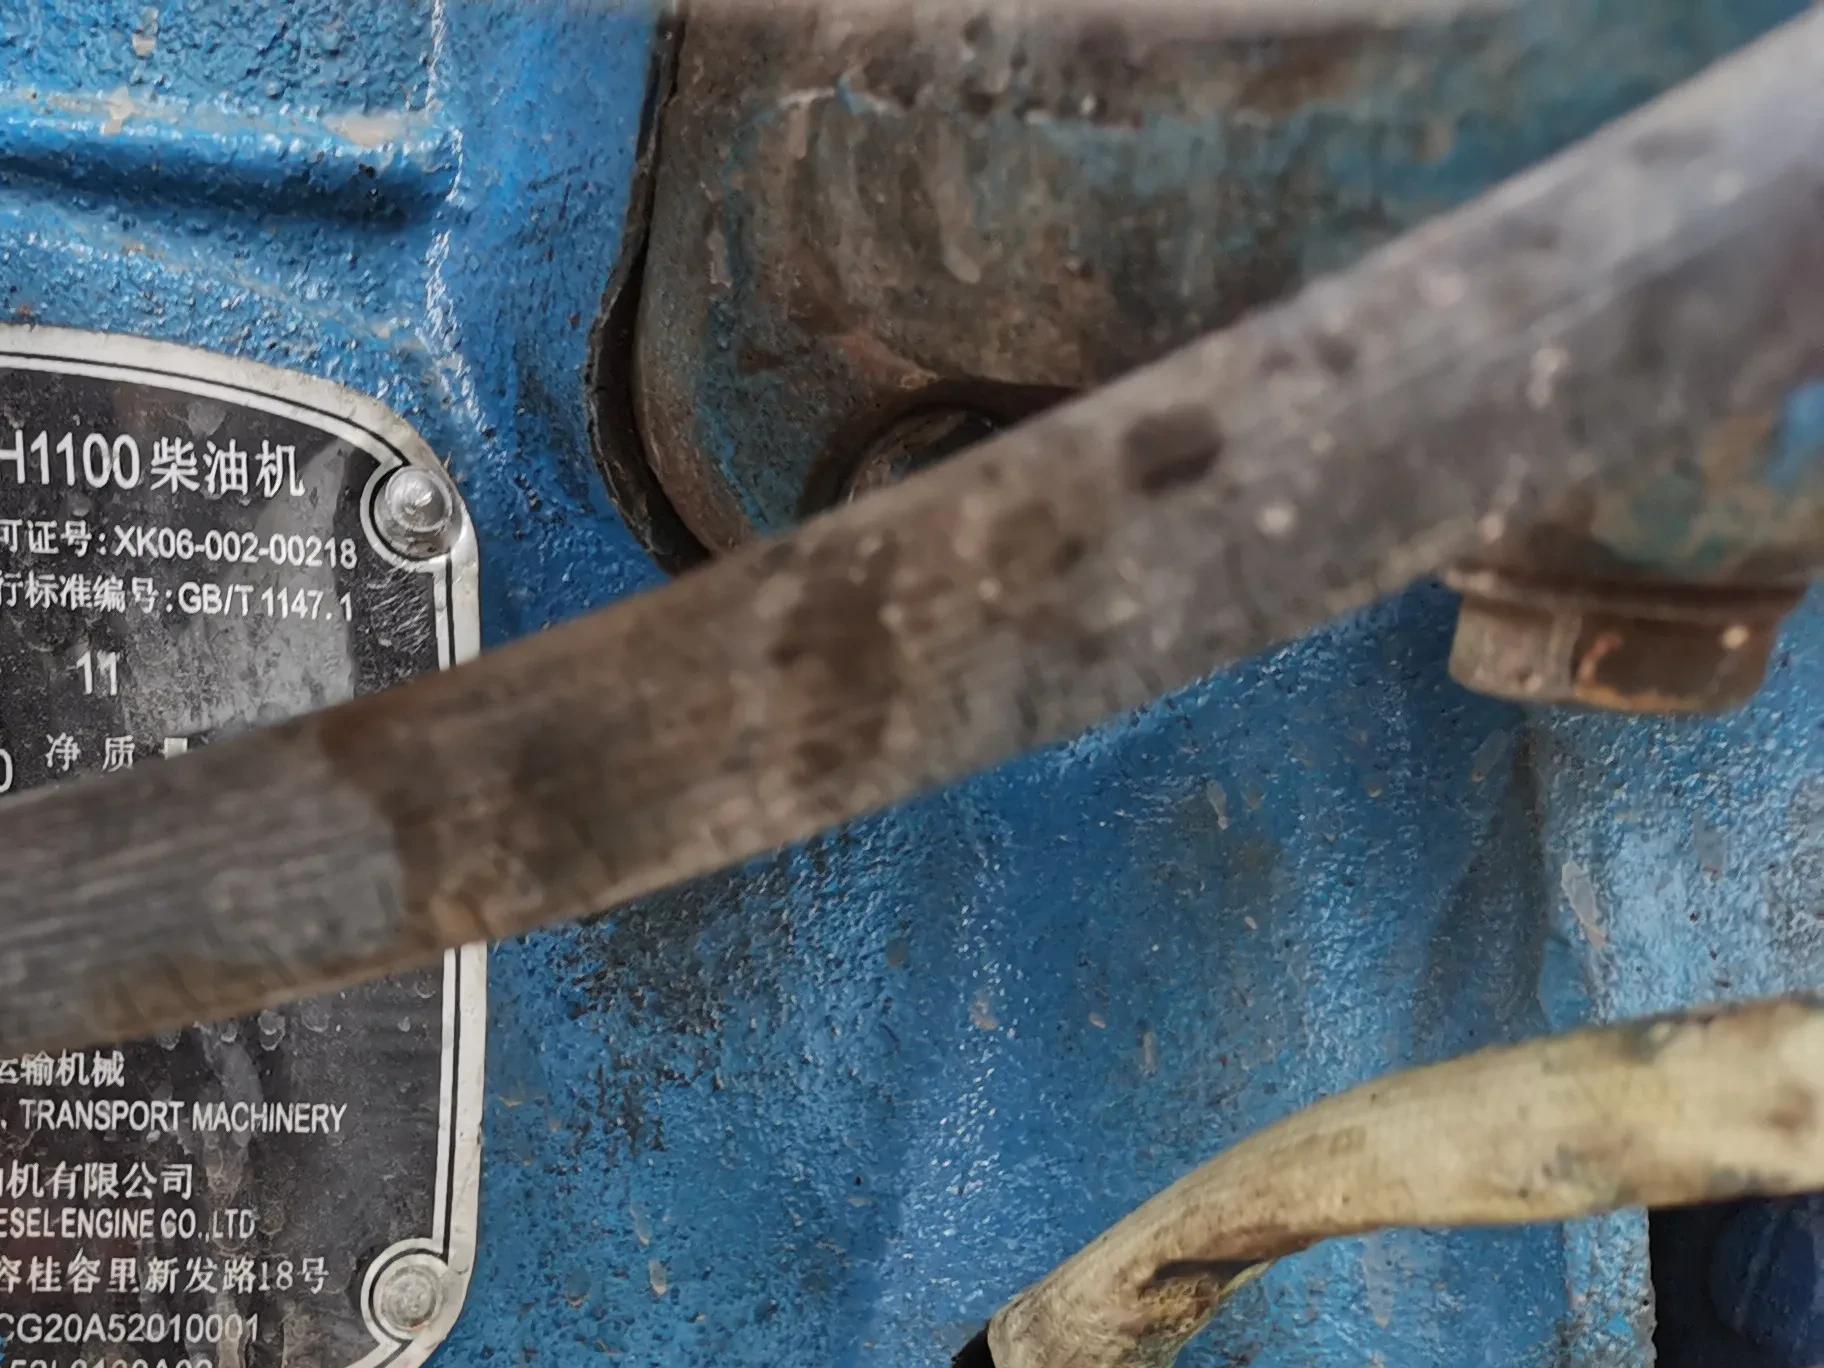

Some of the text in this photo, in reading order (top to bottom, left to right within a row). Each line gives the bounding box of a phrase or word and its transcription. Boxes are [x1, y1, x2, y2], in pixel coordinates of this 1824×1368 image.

[75, 651, 118, 696] 11
[20, 1099, 184, 1131] TRANSPORT
[193, 1102, 348, 1134] MACHINERY
[62, 1208, 154, 1240] ENGINE
